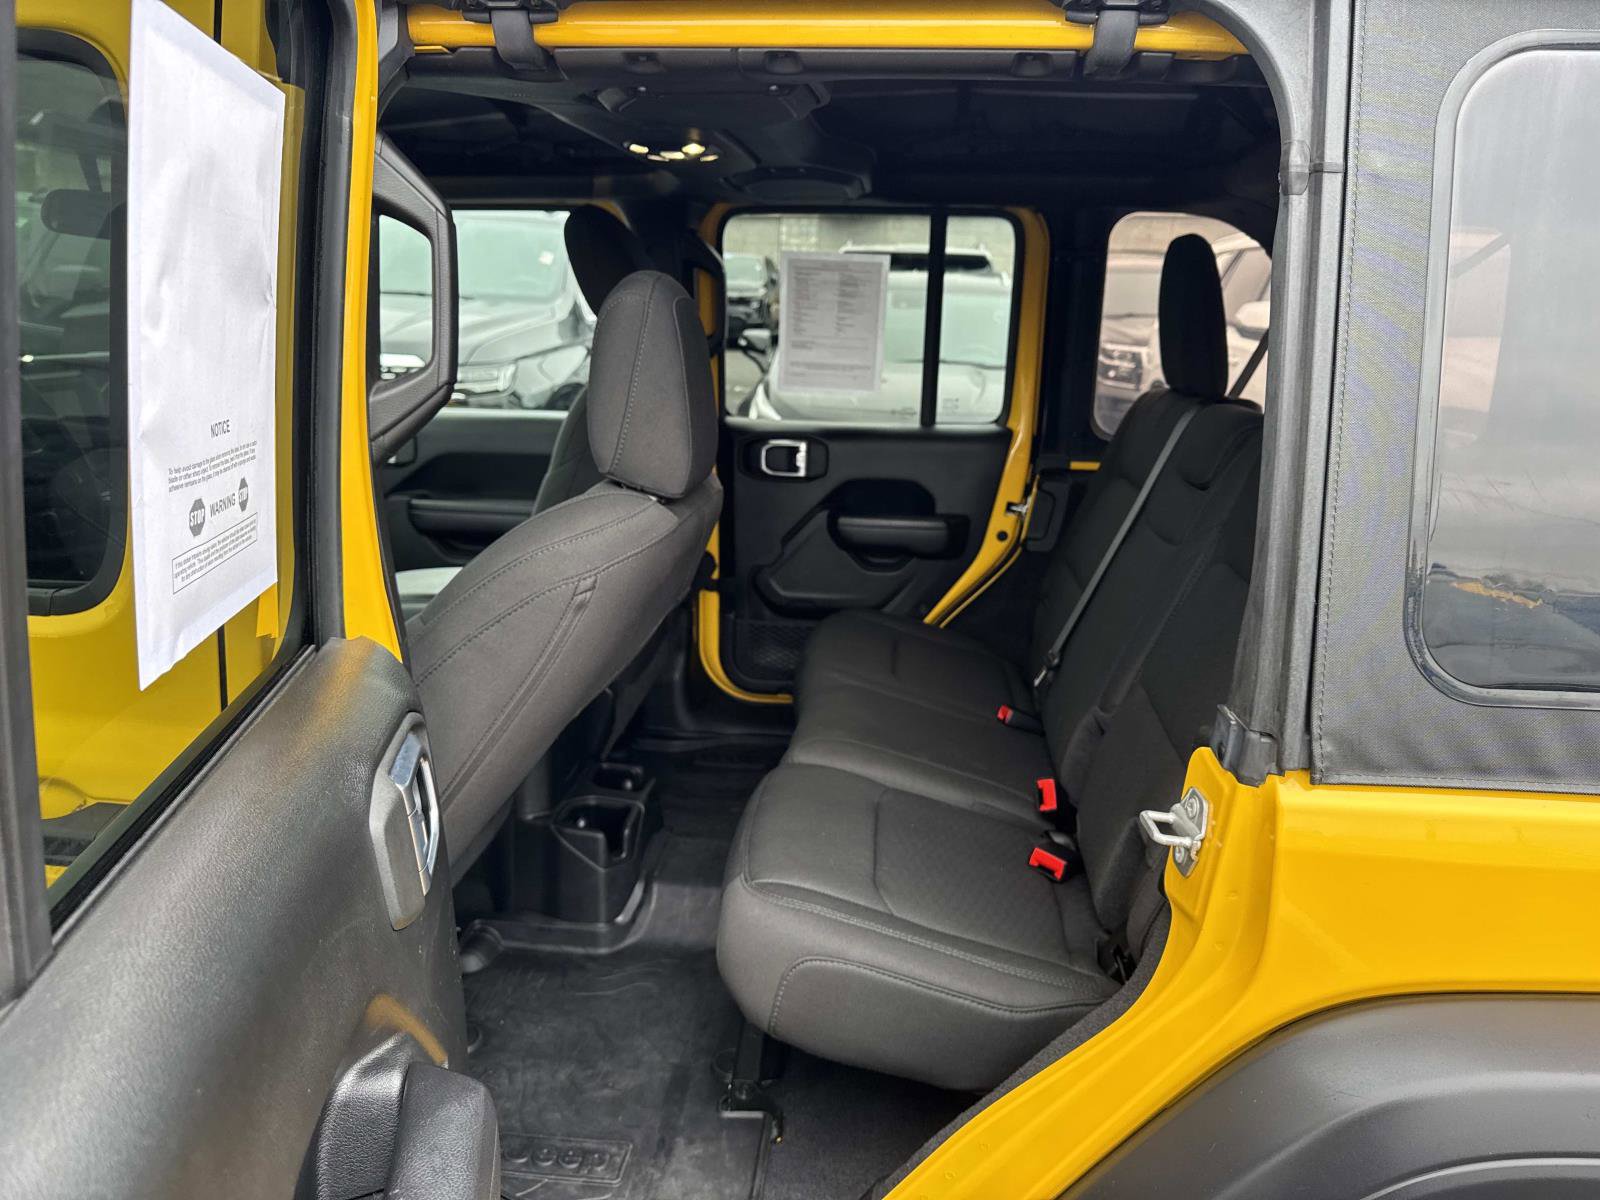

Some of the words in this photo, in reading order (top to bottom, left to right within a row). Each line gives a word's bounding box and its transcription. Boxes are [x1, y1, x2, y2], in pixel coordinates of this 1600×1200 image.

[210, 419, 231, 438] NOTICE
[209, 493, 236, 518] WARNING
[190, 508, 205, 527] STOP
